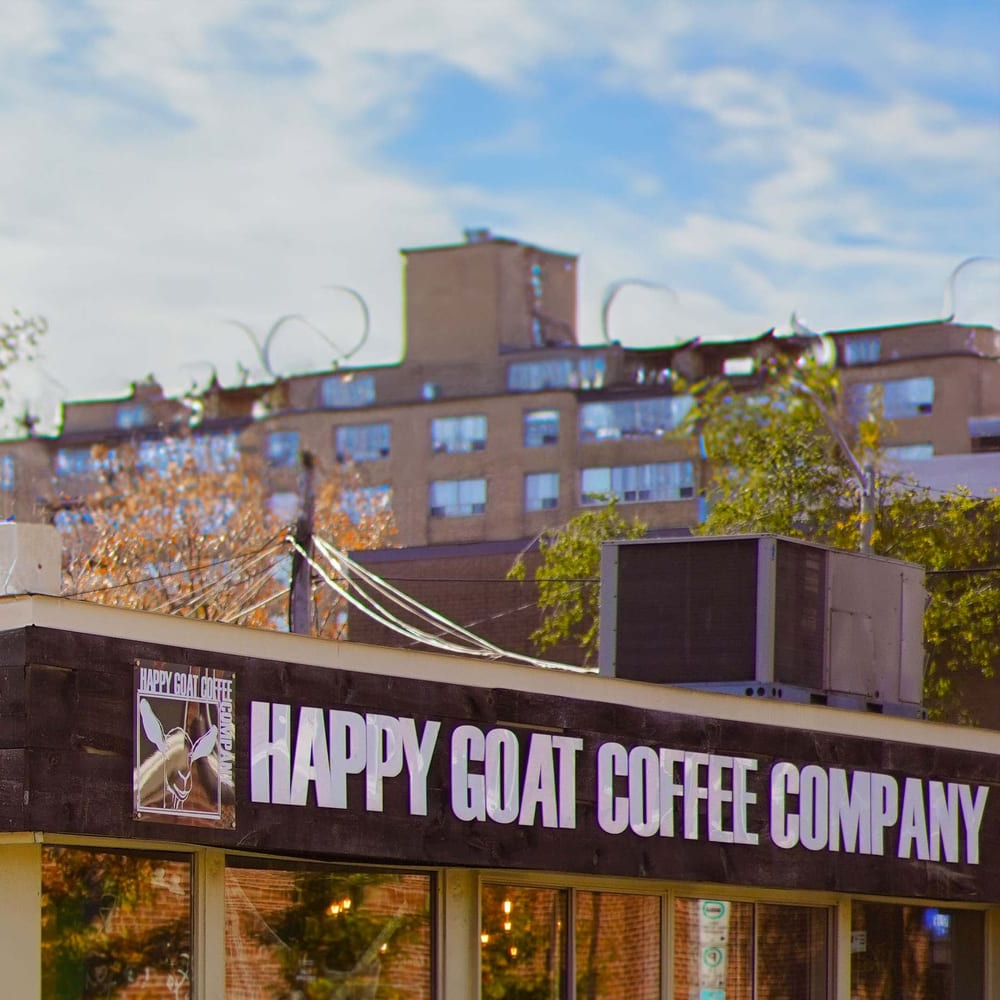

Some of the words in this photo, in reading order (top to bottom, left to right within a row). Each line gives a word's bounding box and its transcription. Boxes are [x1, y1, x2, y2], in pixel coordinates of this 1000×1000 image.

[140, 667, 173, 695] HAPPY
[173, 672, 199, 699] GOAT
[201, 675, 232, 703] COFFEE
[219, 702, 233, 784] COMPANY
[250, 701, 441, 817] HAPPY
[451, 725, 583, 829] GOAT
[597, 742, 759, 845] COFFEE
[770, 762, 989, 865] COMPANY
